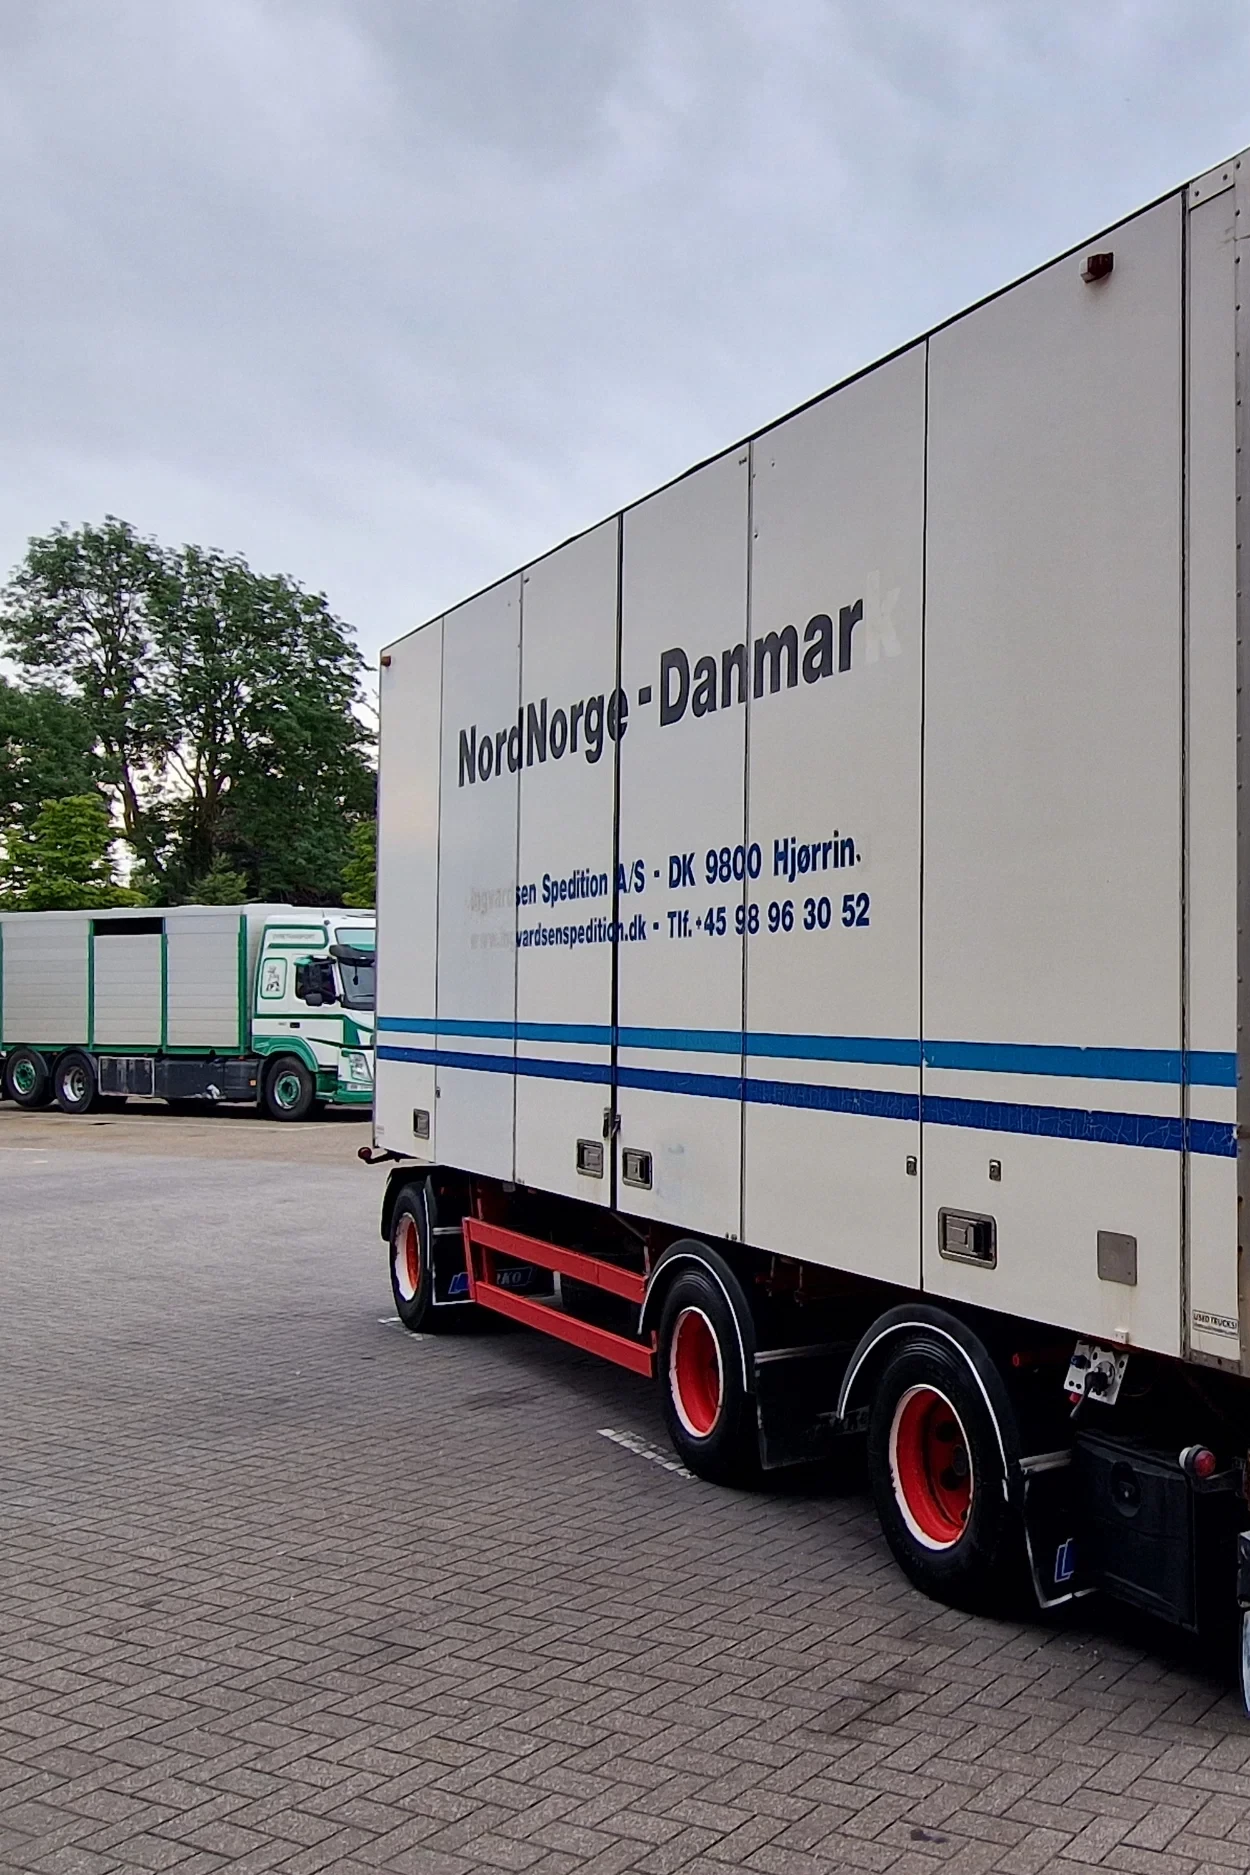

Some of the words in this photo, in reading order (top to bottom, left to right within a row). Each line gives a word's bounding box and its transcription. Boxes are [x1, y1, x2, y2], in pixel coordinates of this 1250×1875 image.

[457, 687, 629, 788] NordNorge
[541, 867, 609, 909] Spedition
[668, 852, 696, 889] DK
[705, 842, 762, 885] 9800
[735, 903, 760, 935] 98
[768, 900, 795, 933] 96
[803, 896, 832, 931] 30
[841, 892, 871, 928] 52
